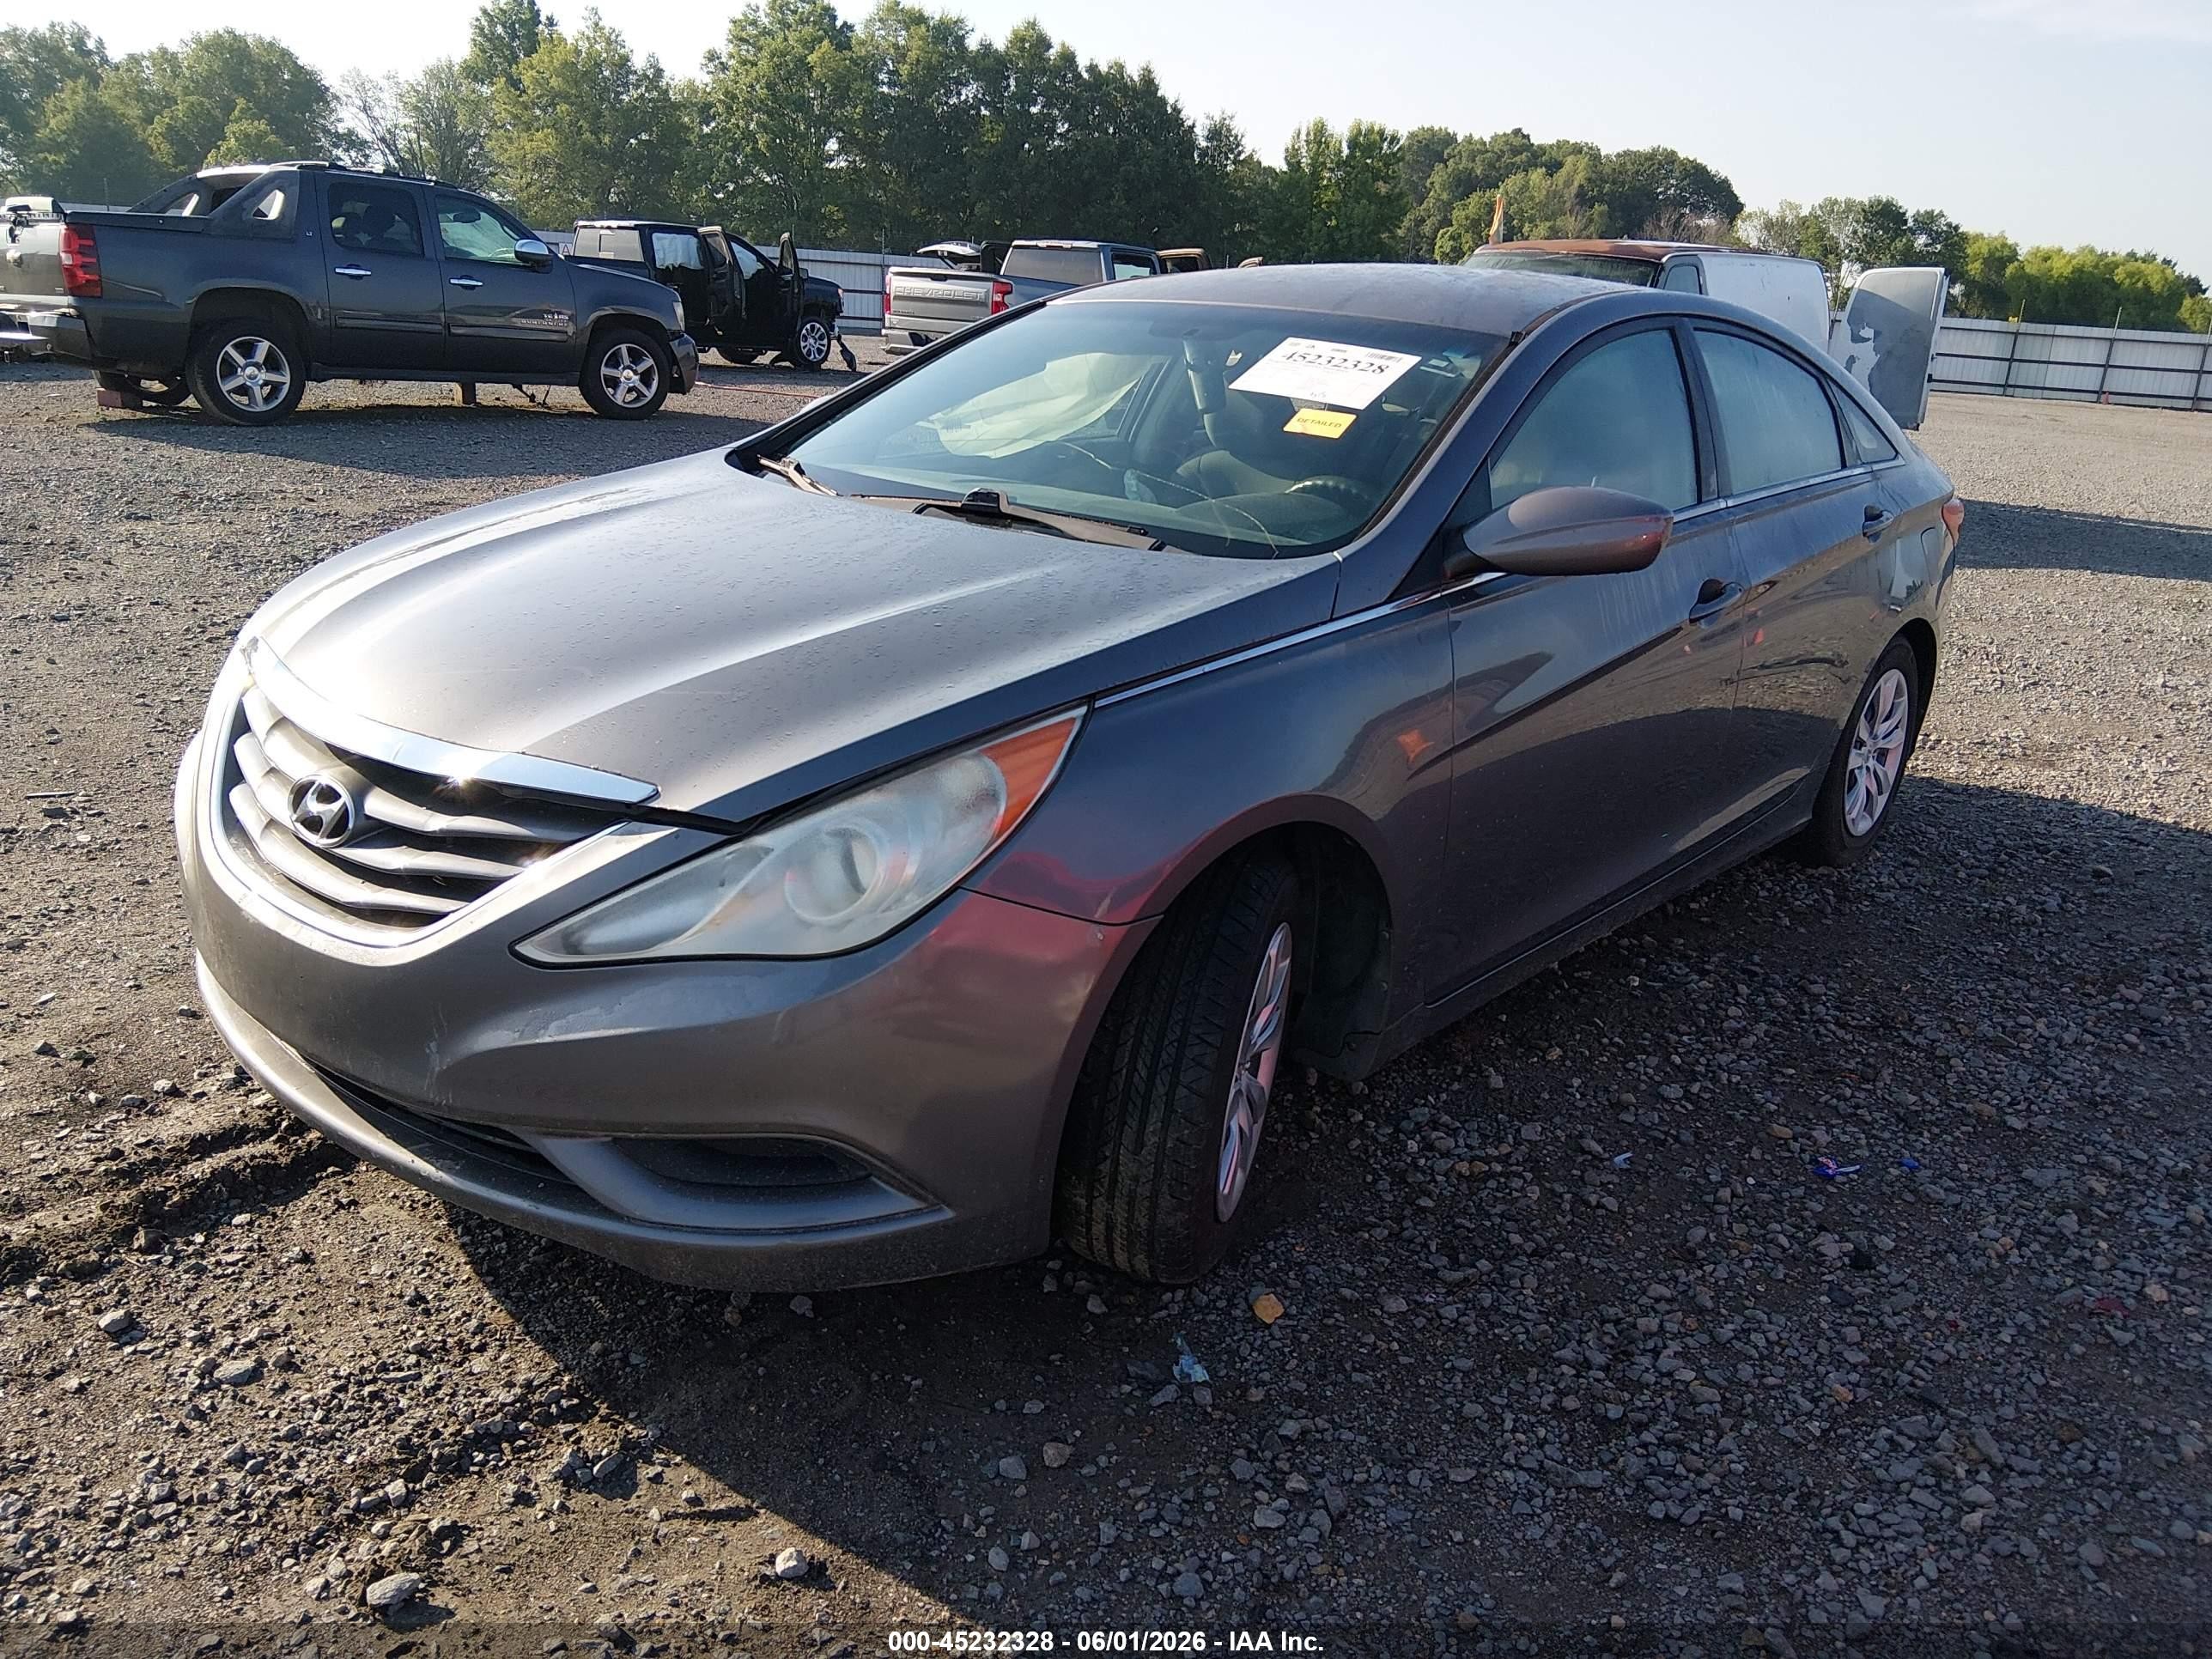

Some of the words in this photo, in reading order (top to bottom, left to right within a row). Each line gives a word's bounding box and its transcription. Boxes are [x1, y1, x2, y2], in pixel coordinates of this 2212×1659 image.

[894, 286, 985, 301] CHEVROLET
[1282, 351, 1389, 374] 45232328
[1297, 417, 1342, 428] DETAILED
